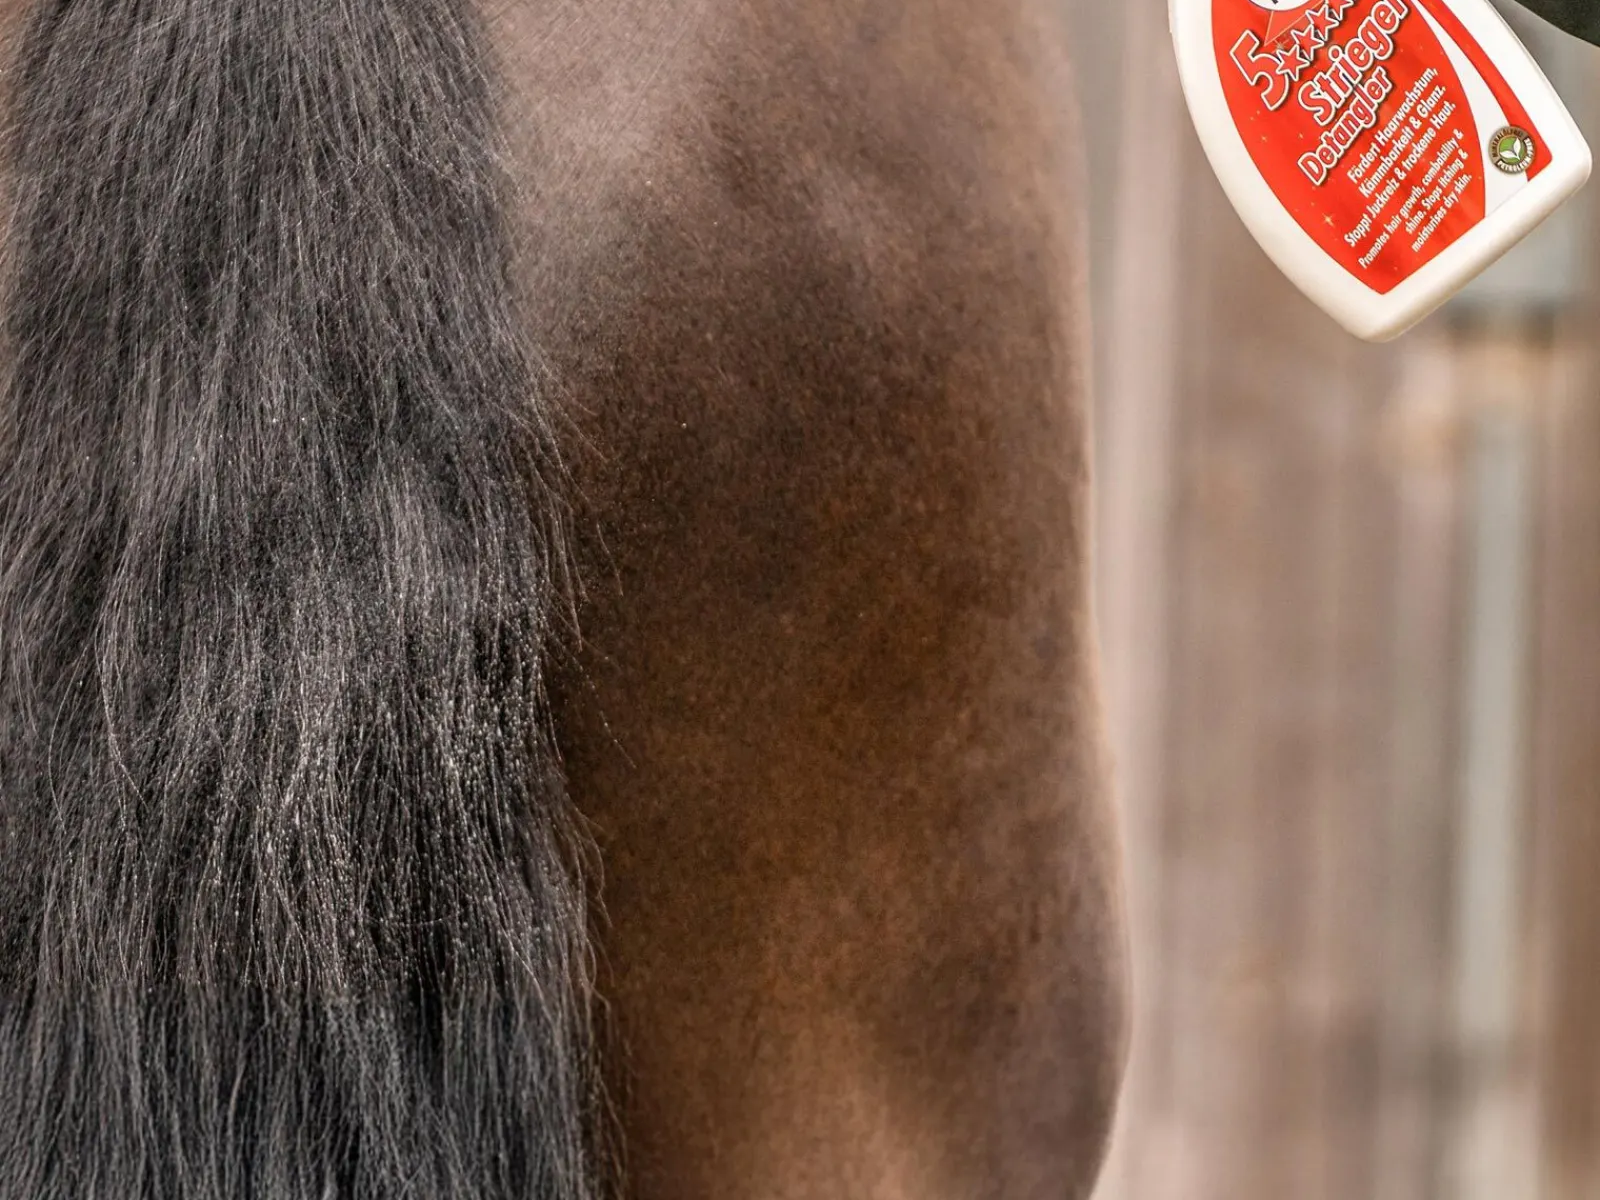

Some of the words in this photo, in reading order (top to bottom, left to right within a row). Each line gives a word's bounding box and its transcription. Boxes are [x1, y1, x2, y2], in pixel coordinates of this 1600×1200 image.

[1298, 66, 1392, 184] Detangler
[1344, 214, 1372, 246] Stoppt
[1367, 178, 1399, 218] Juckreiz
[1394, 168, 1406, 180] &
[1402, 128, 1436, 170] trockene
[1430, 101, 1455, 129] Haut.
[1347, 143, 1380, 183] Fördert
[1375, 68, 1437, 146] Haarwachstum,
[1359, 126, 1414, 197] Kämmbarkeit
[1410, 116, 1422, 129] &
[1417, 86, 1445, 118] Glanz.
[1358, 232, 1389, 268] Promotes
[1384, 215, 1401, 233] hair
[1400, 186, 1425, 218] growth,
[1422, 138, 1458, 185] combability
[1454, 129, 1463, 139] &
[1406, 211, 1426, 233] shine.
[1422, 186, 1442, 209] Stops
[1438, 158, 1464, 187] itching
[1458, 149, 1468, 159] &
[1412, 207, 1446, 252] moisturises
[1444, 192, 1458, 208] dry
[1455, 175, 1471, 194] skin.
